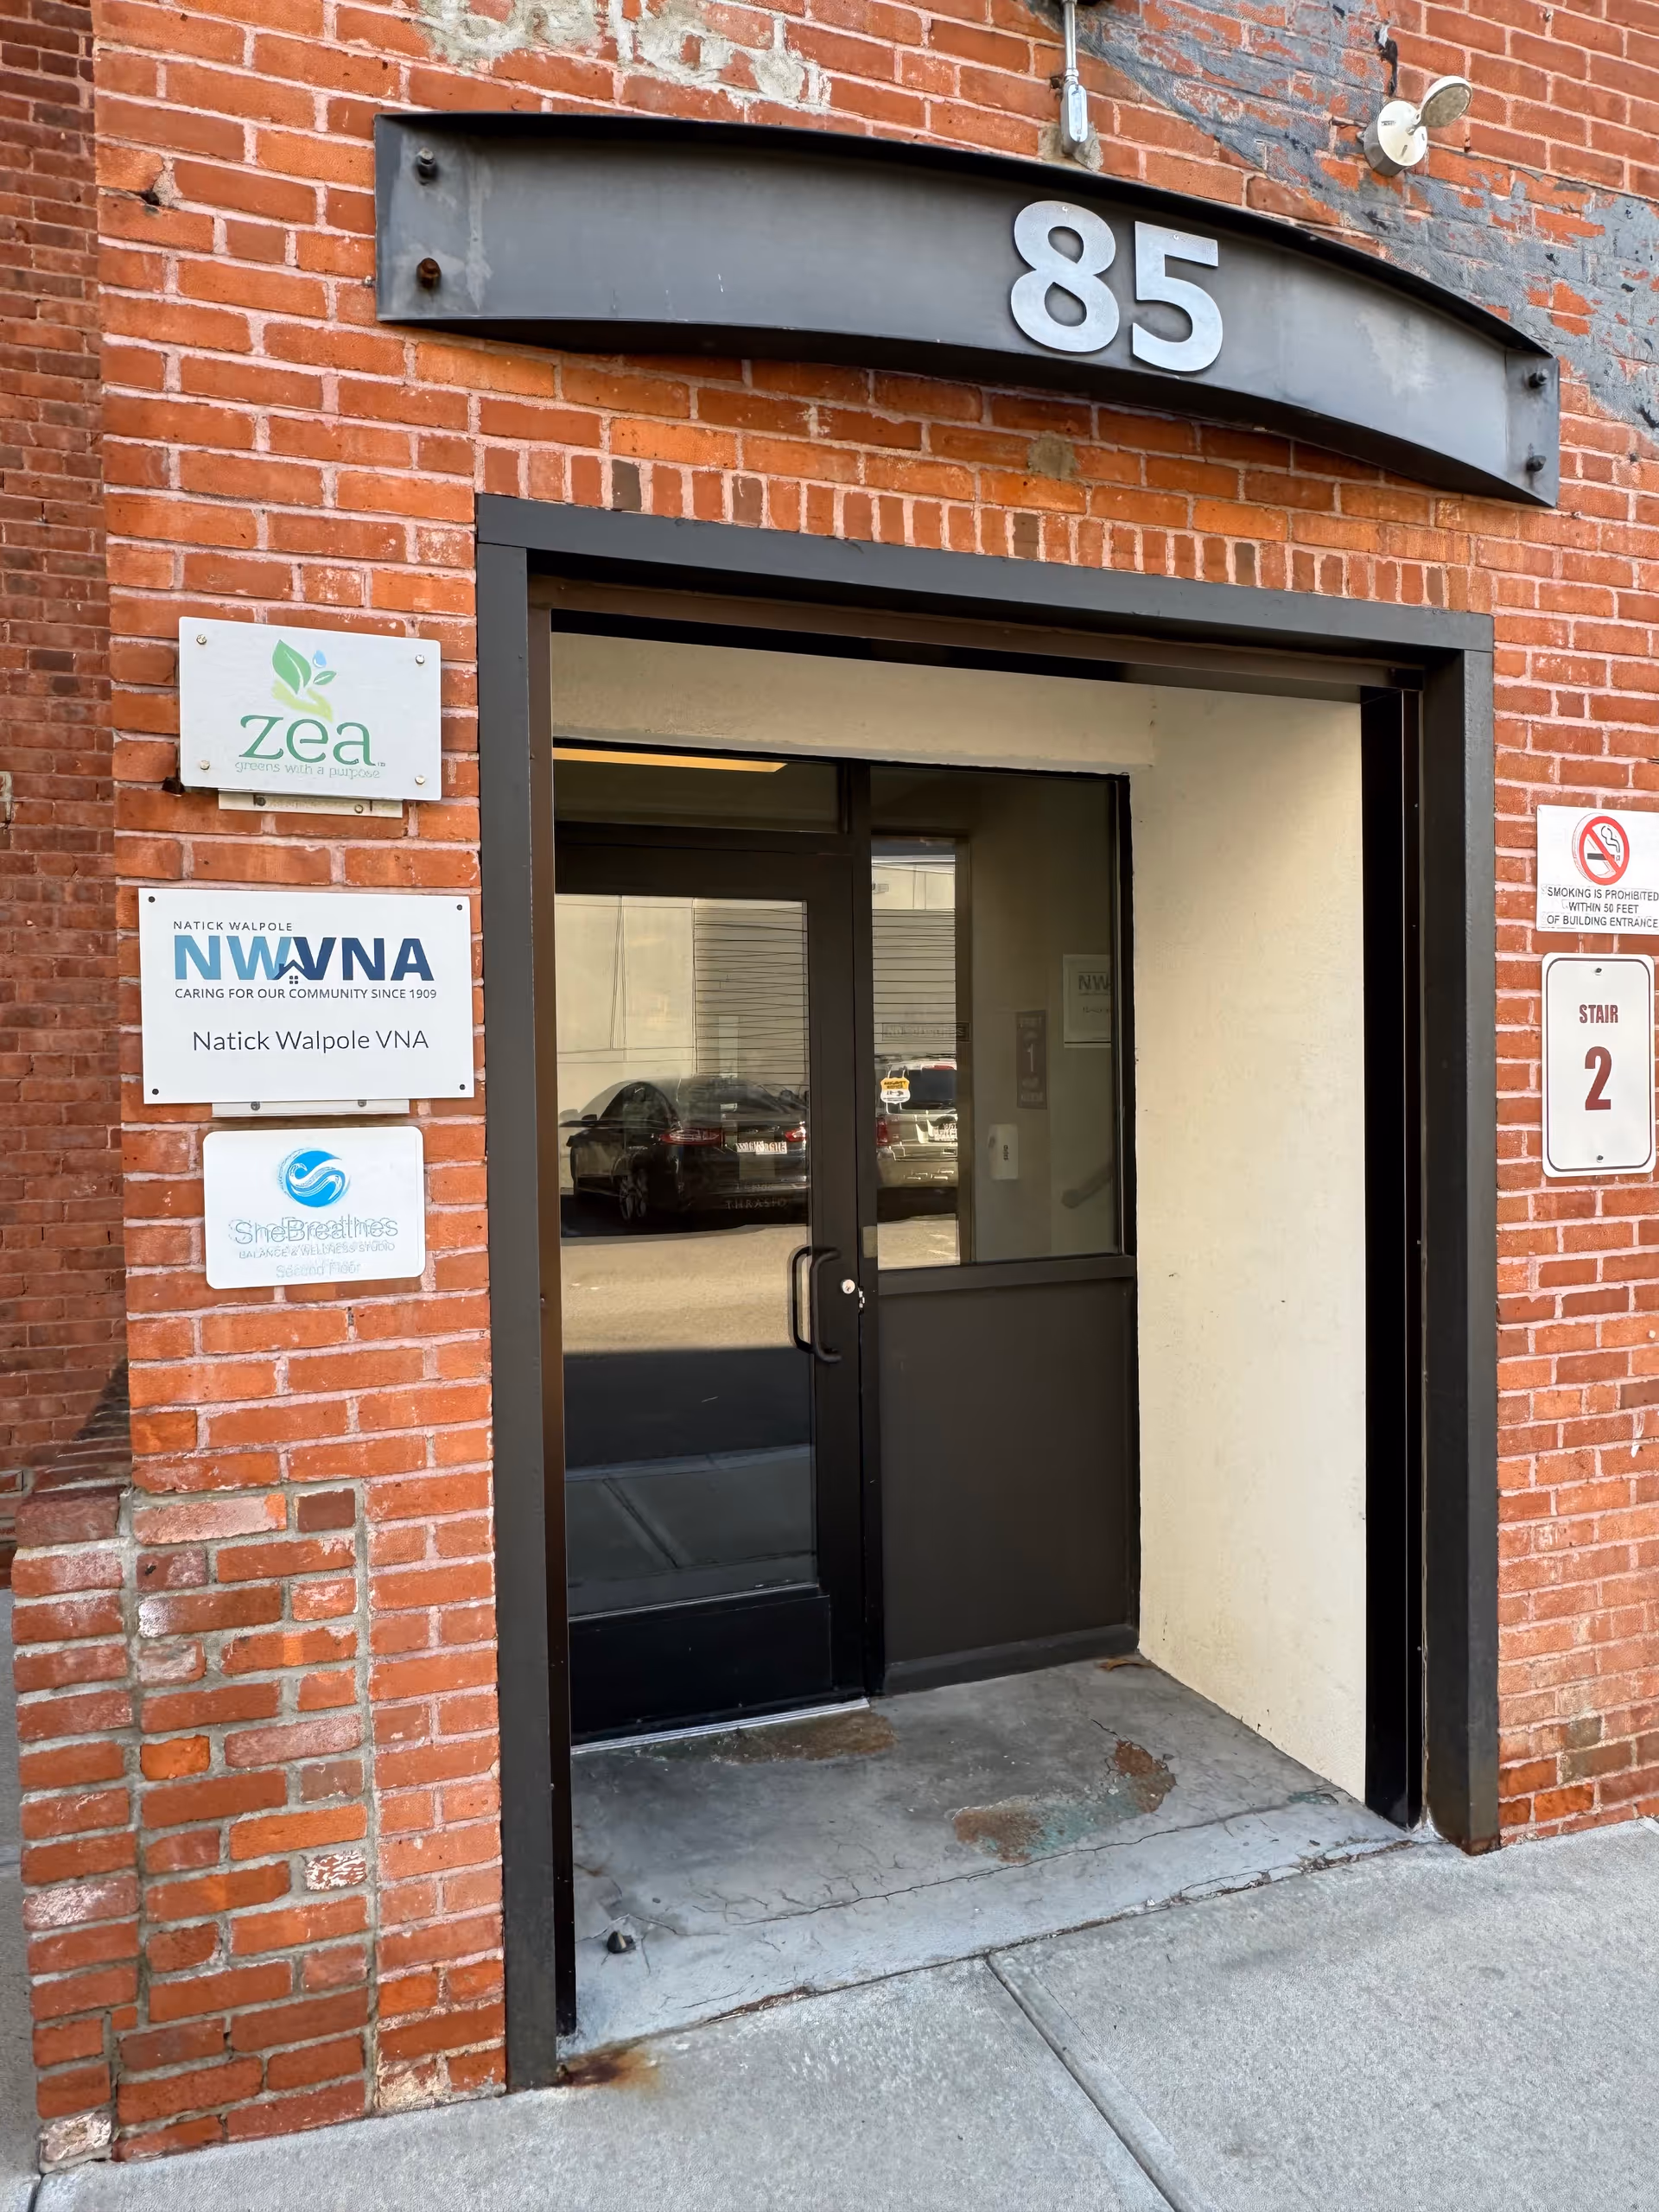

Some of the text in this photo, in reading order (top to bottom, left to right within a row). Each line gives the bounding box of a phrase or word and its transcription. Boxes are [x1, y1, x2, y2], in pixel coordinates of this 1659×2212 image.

[1010, 200, 1224, 372] 85
[238, 715, 376, 766] zea
[235, 761, 380, 779] greens with a purpose
[1547, 887, 1659, 901] SMOKING IS PROHIBITED
[1568, 901, 1639, 913] WITHIN 50 FEET
[173, 921, 293, 931] NATICK WALPOLE
[1547, 915, 1659, 928] OF BUILDING ENTRANCE
[175, 988, 437, 999] CARING FOR OUR COMMUNITY SINCE 1909
[1579, 1004, 1619, 1023] STAIR
[193, 1030, 429, 1054] Natick Walpole VNA
[1584, 1046, 1612, 1111] 2
[232, 1214, 398, 1245] SheBreathes
[276, 1262, 325, 1278] Second
